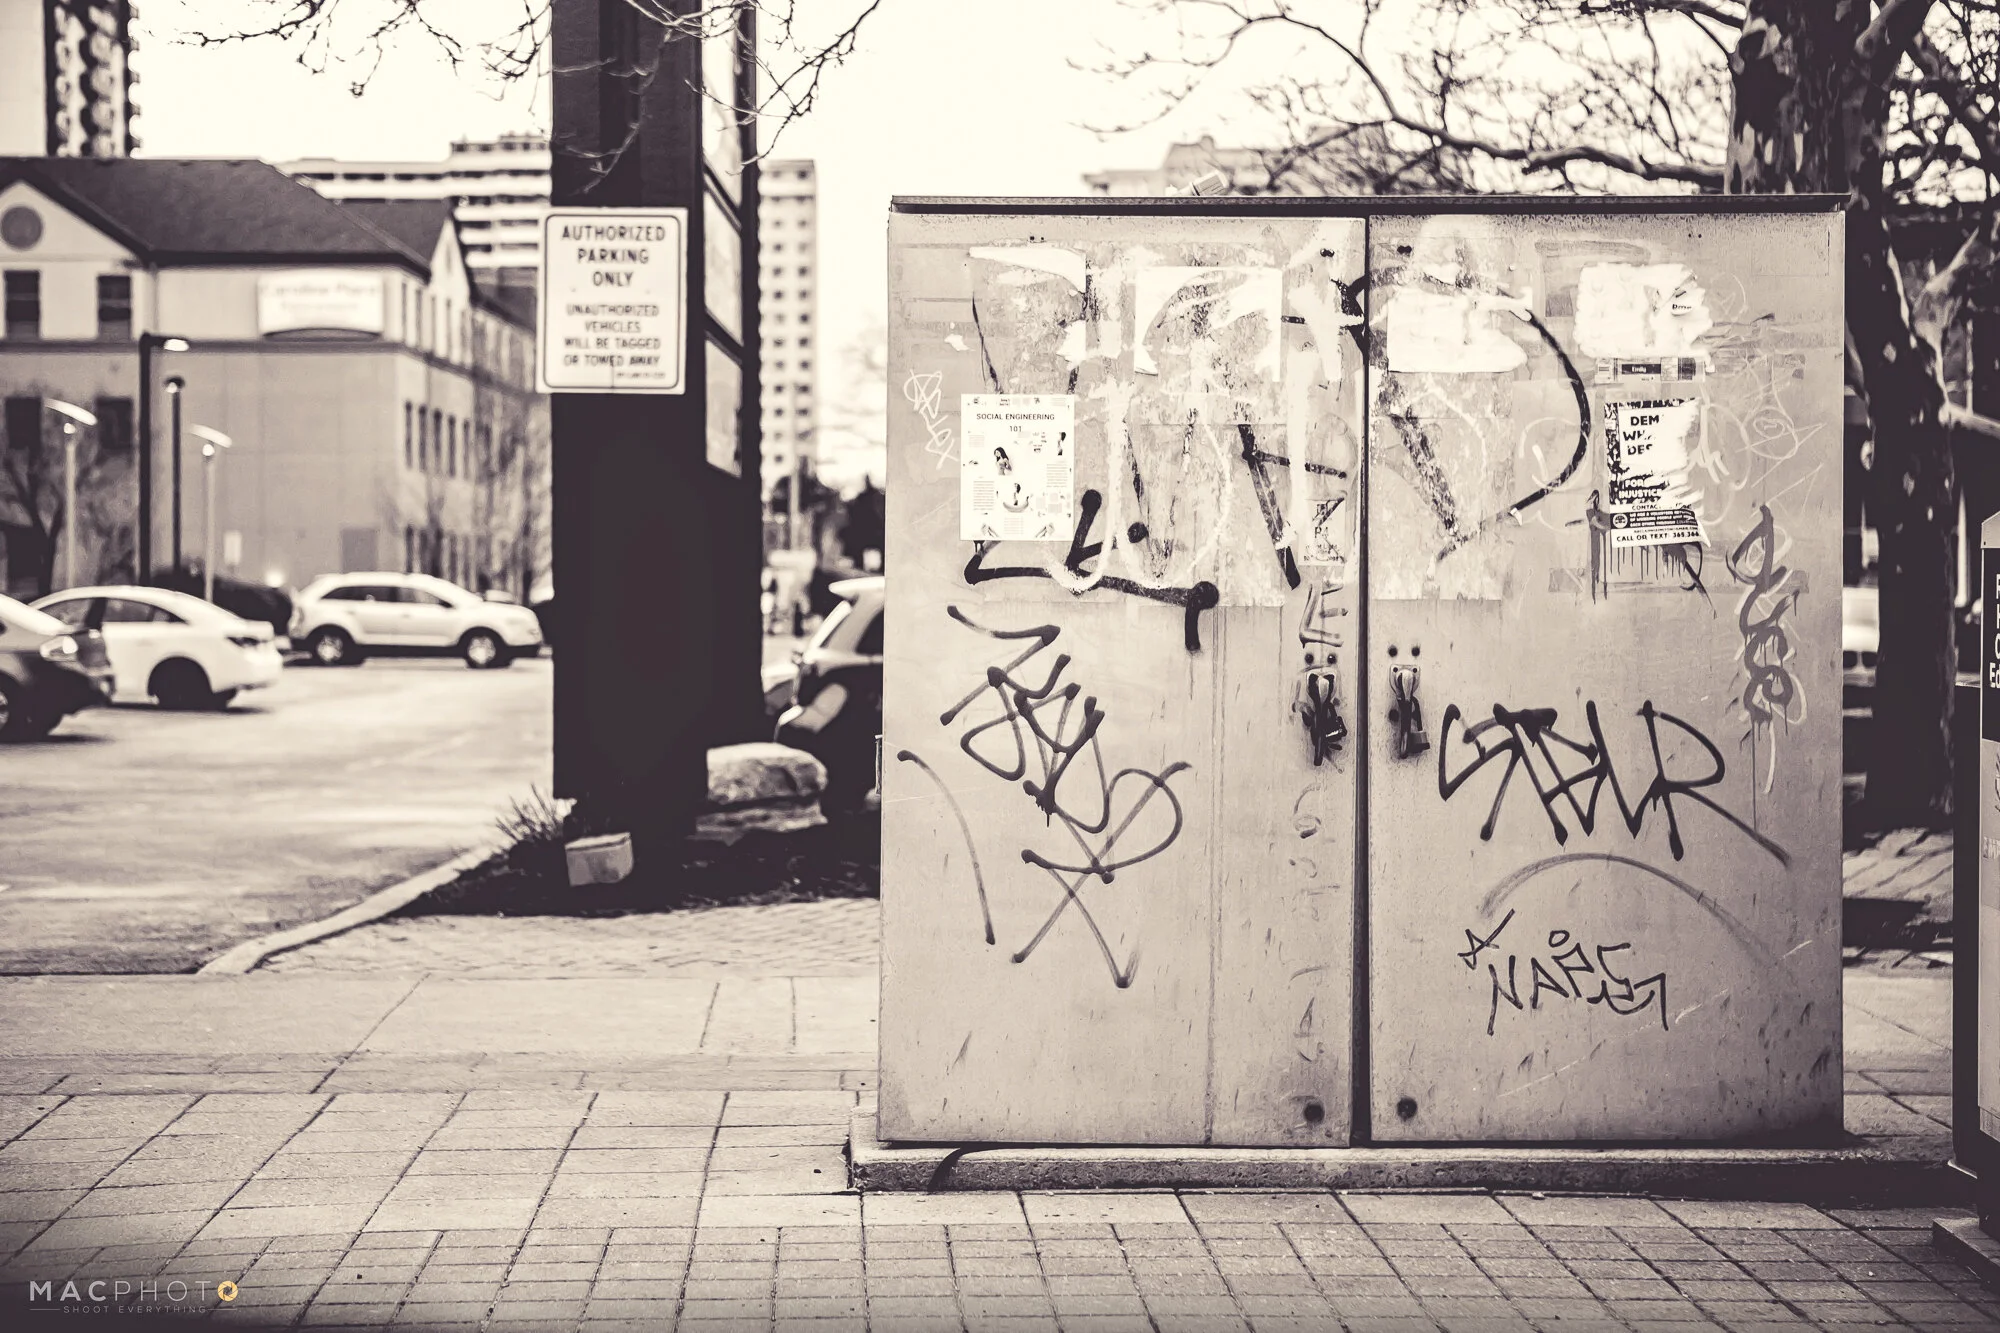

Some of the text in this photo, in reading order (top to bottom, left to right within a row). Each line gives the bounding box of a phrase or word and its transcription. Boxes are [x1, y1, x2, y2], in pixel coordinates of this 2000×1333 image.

[562, 225, 667, 241] AUTHORIZED
[577, 248, 649, 264] PARKING
[592, 271, 634, 287] ONLY
[566, 303, 660, 317] UNAUTHORIZED
[585, 321, 641, 333] VEHICLES
[564, 337, 661, 350] WILL BE TAGGED
[563, 354, 660, 367] OR TOWED AWAY
[976, 413, 1055, 421] SOCIAL ENGINEERING
[1630, 414, 1660, 426] DEM
